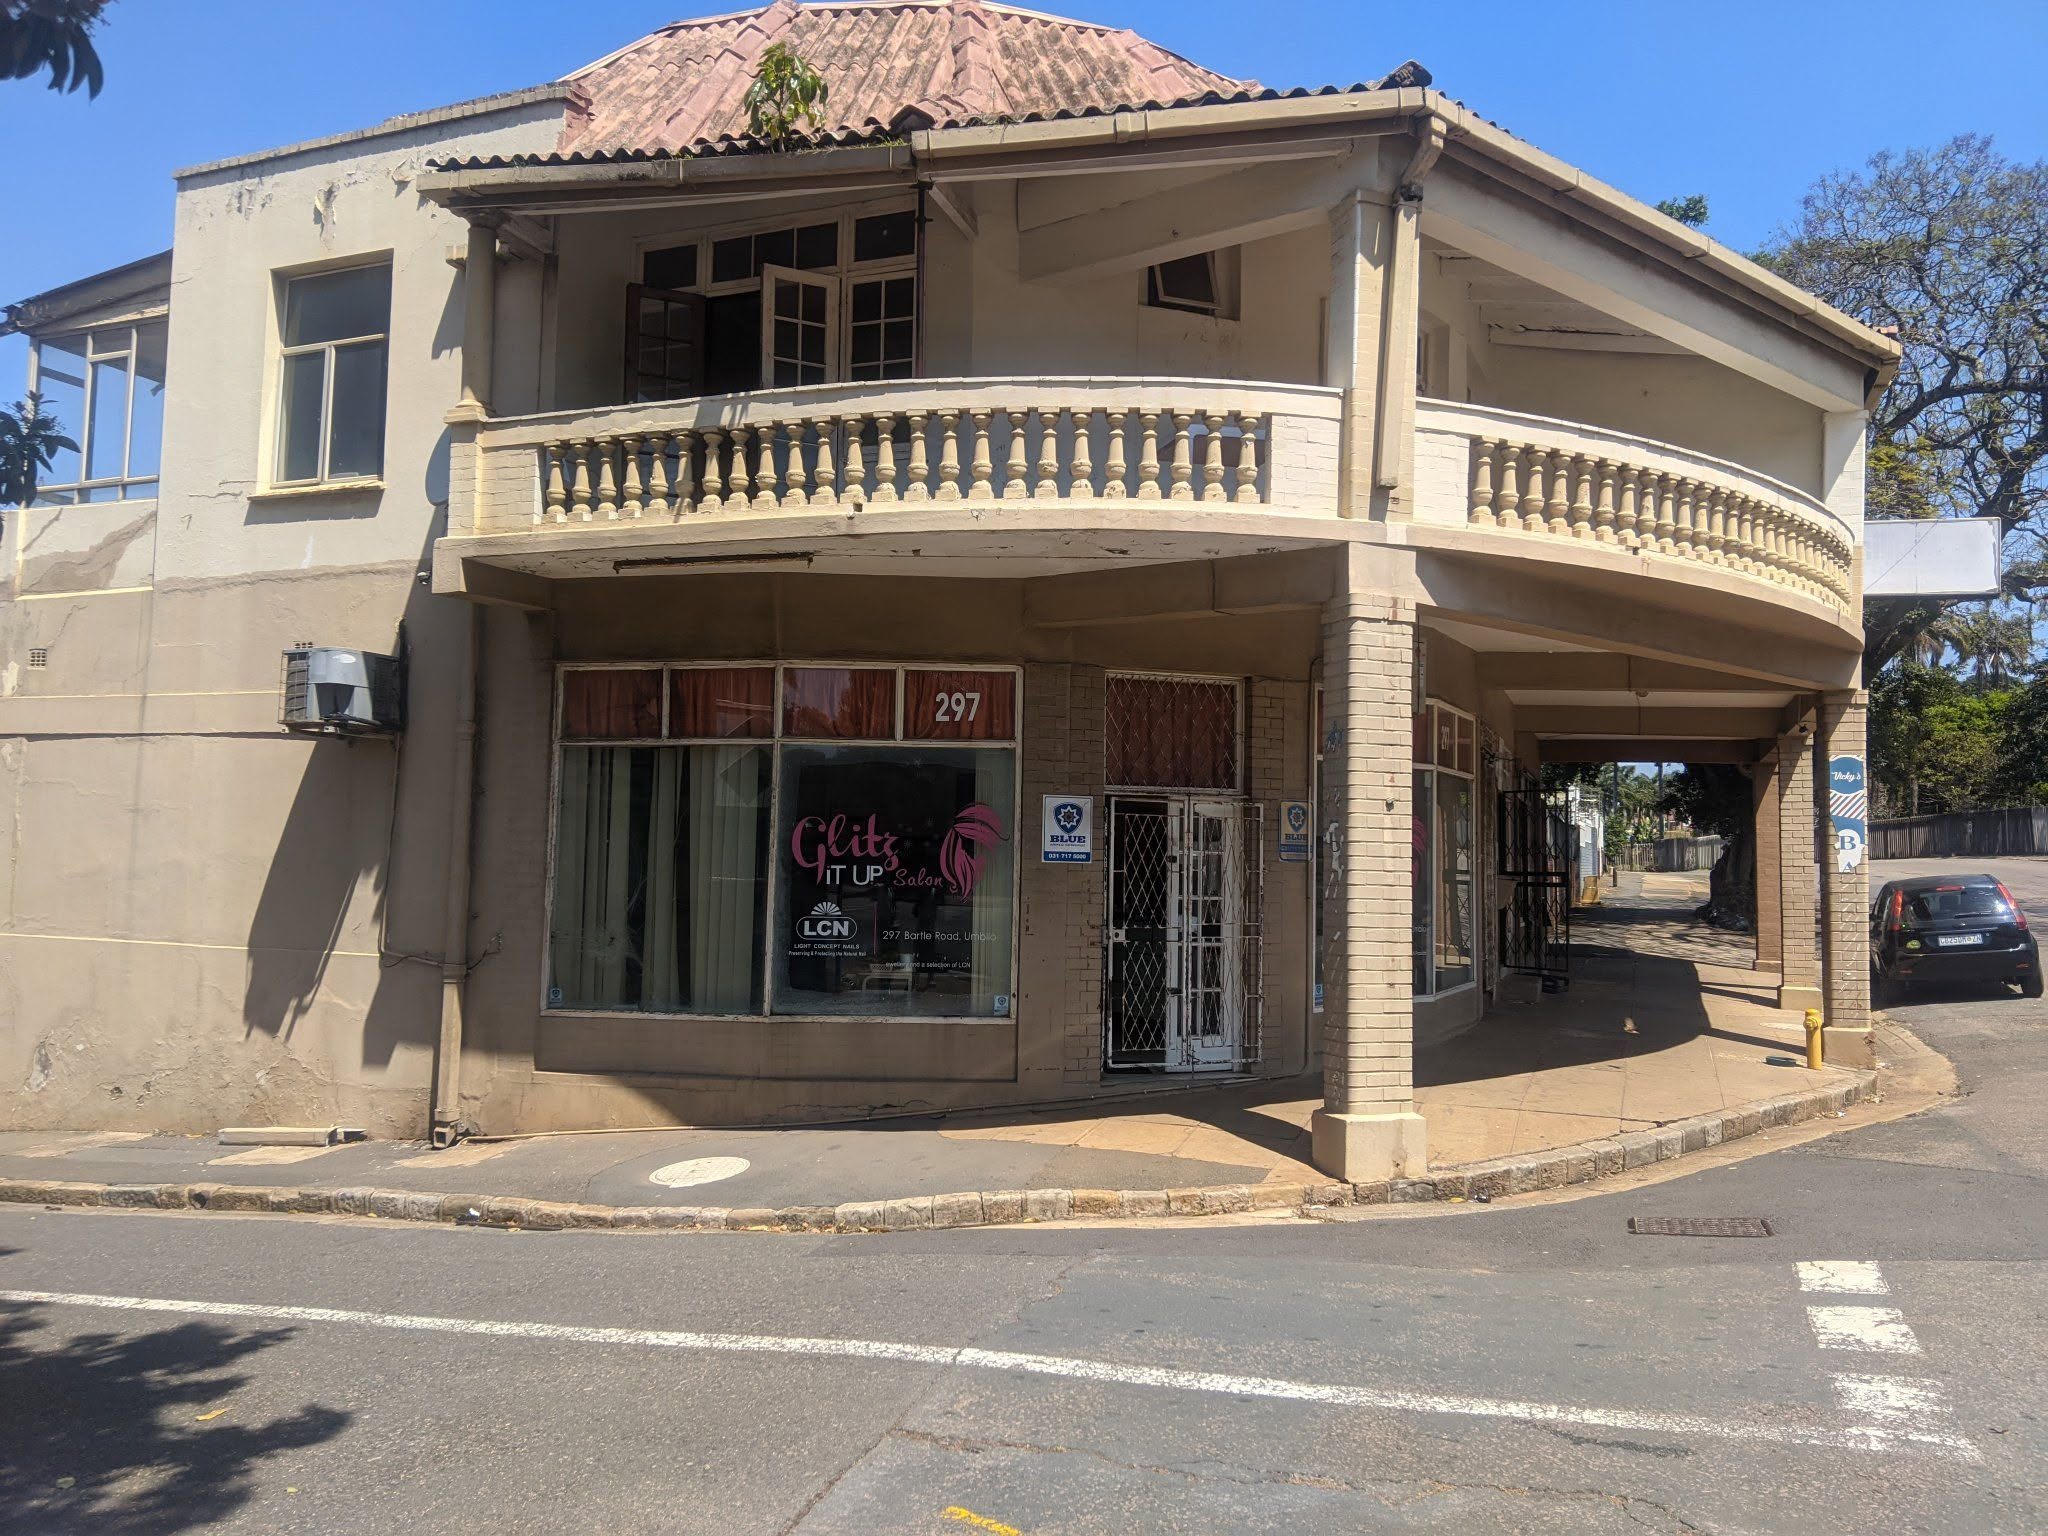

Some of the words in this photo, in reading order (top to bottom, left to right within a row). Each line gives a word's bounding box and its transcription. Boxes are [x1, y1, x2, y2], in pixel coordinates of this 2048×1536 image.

[935, 692, 980, 721] 297
[1050, 835, 1086, 843] BLUE
[791, 813, 900, 886] Glitz
[853, 864, 884, 885] UP
[892, 867, 944, 887] Salon
[803, 921, 849, 936] LCN
[882, 930, 901, 940] 297
[904, 930, 932, 940] Bartle
